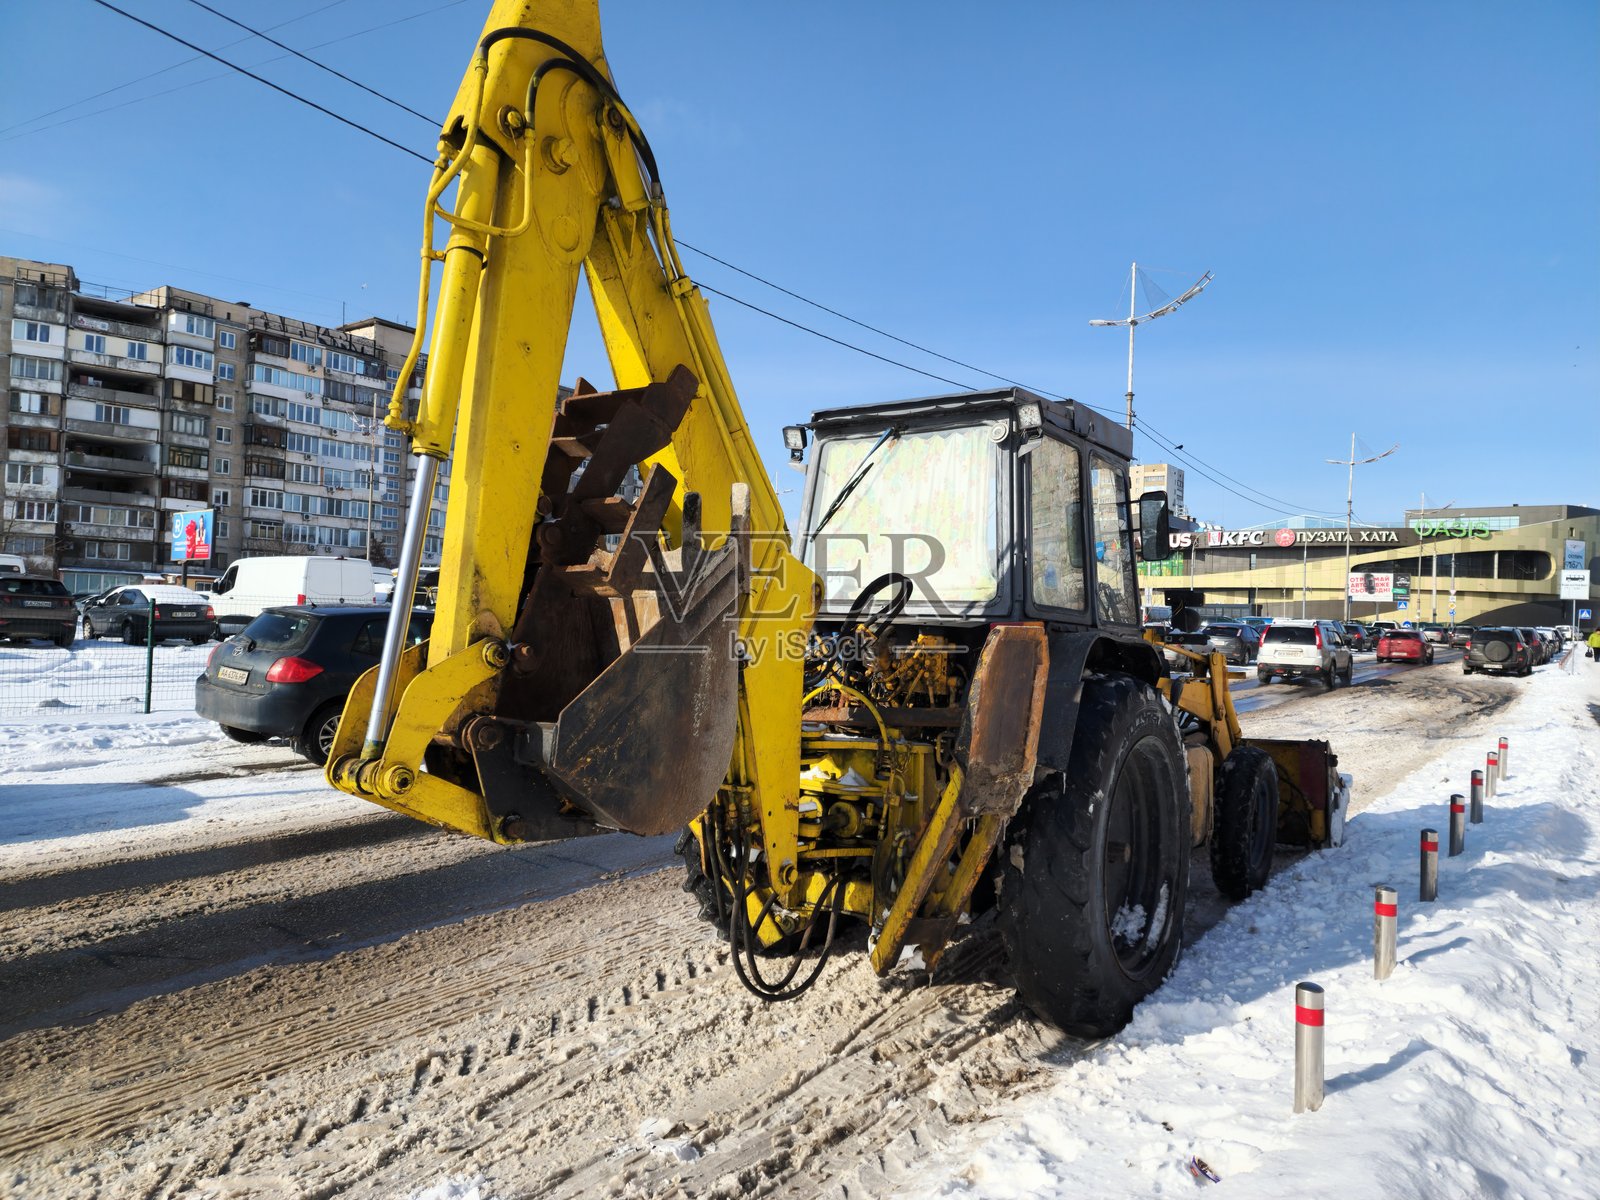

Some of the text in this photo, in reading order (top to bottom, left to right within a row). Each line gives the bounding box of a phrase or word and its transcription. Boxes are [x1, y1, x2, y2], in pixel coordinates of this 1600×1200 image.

[1296, 530, 1399, 543] ПУЗАТА ХАТА
[1414, 520, 1490, 538] OASIS
[1169, 532, 1191, 548] US
[1221, 530, 1265, 546] KFC
